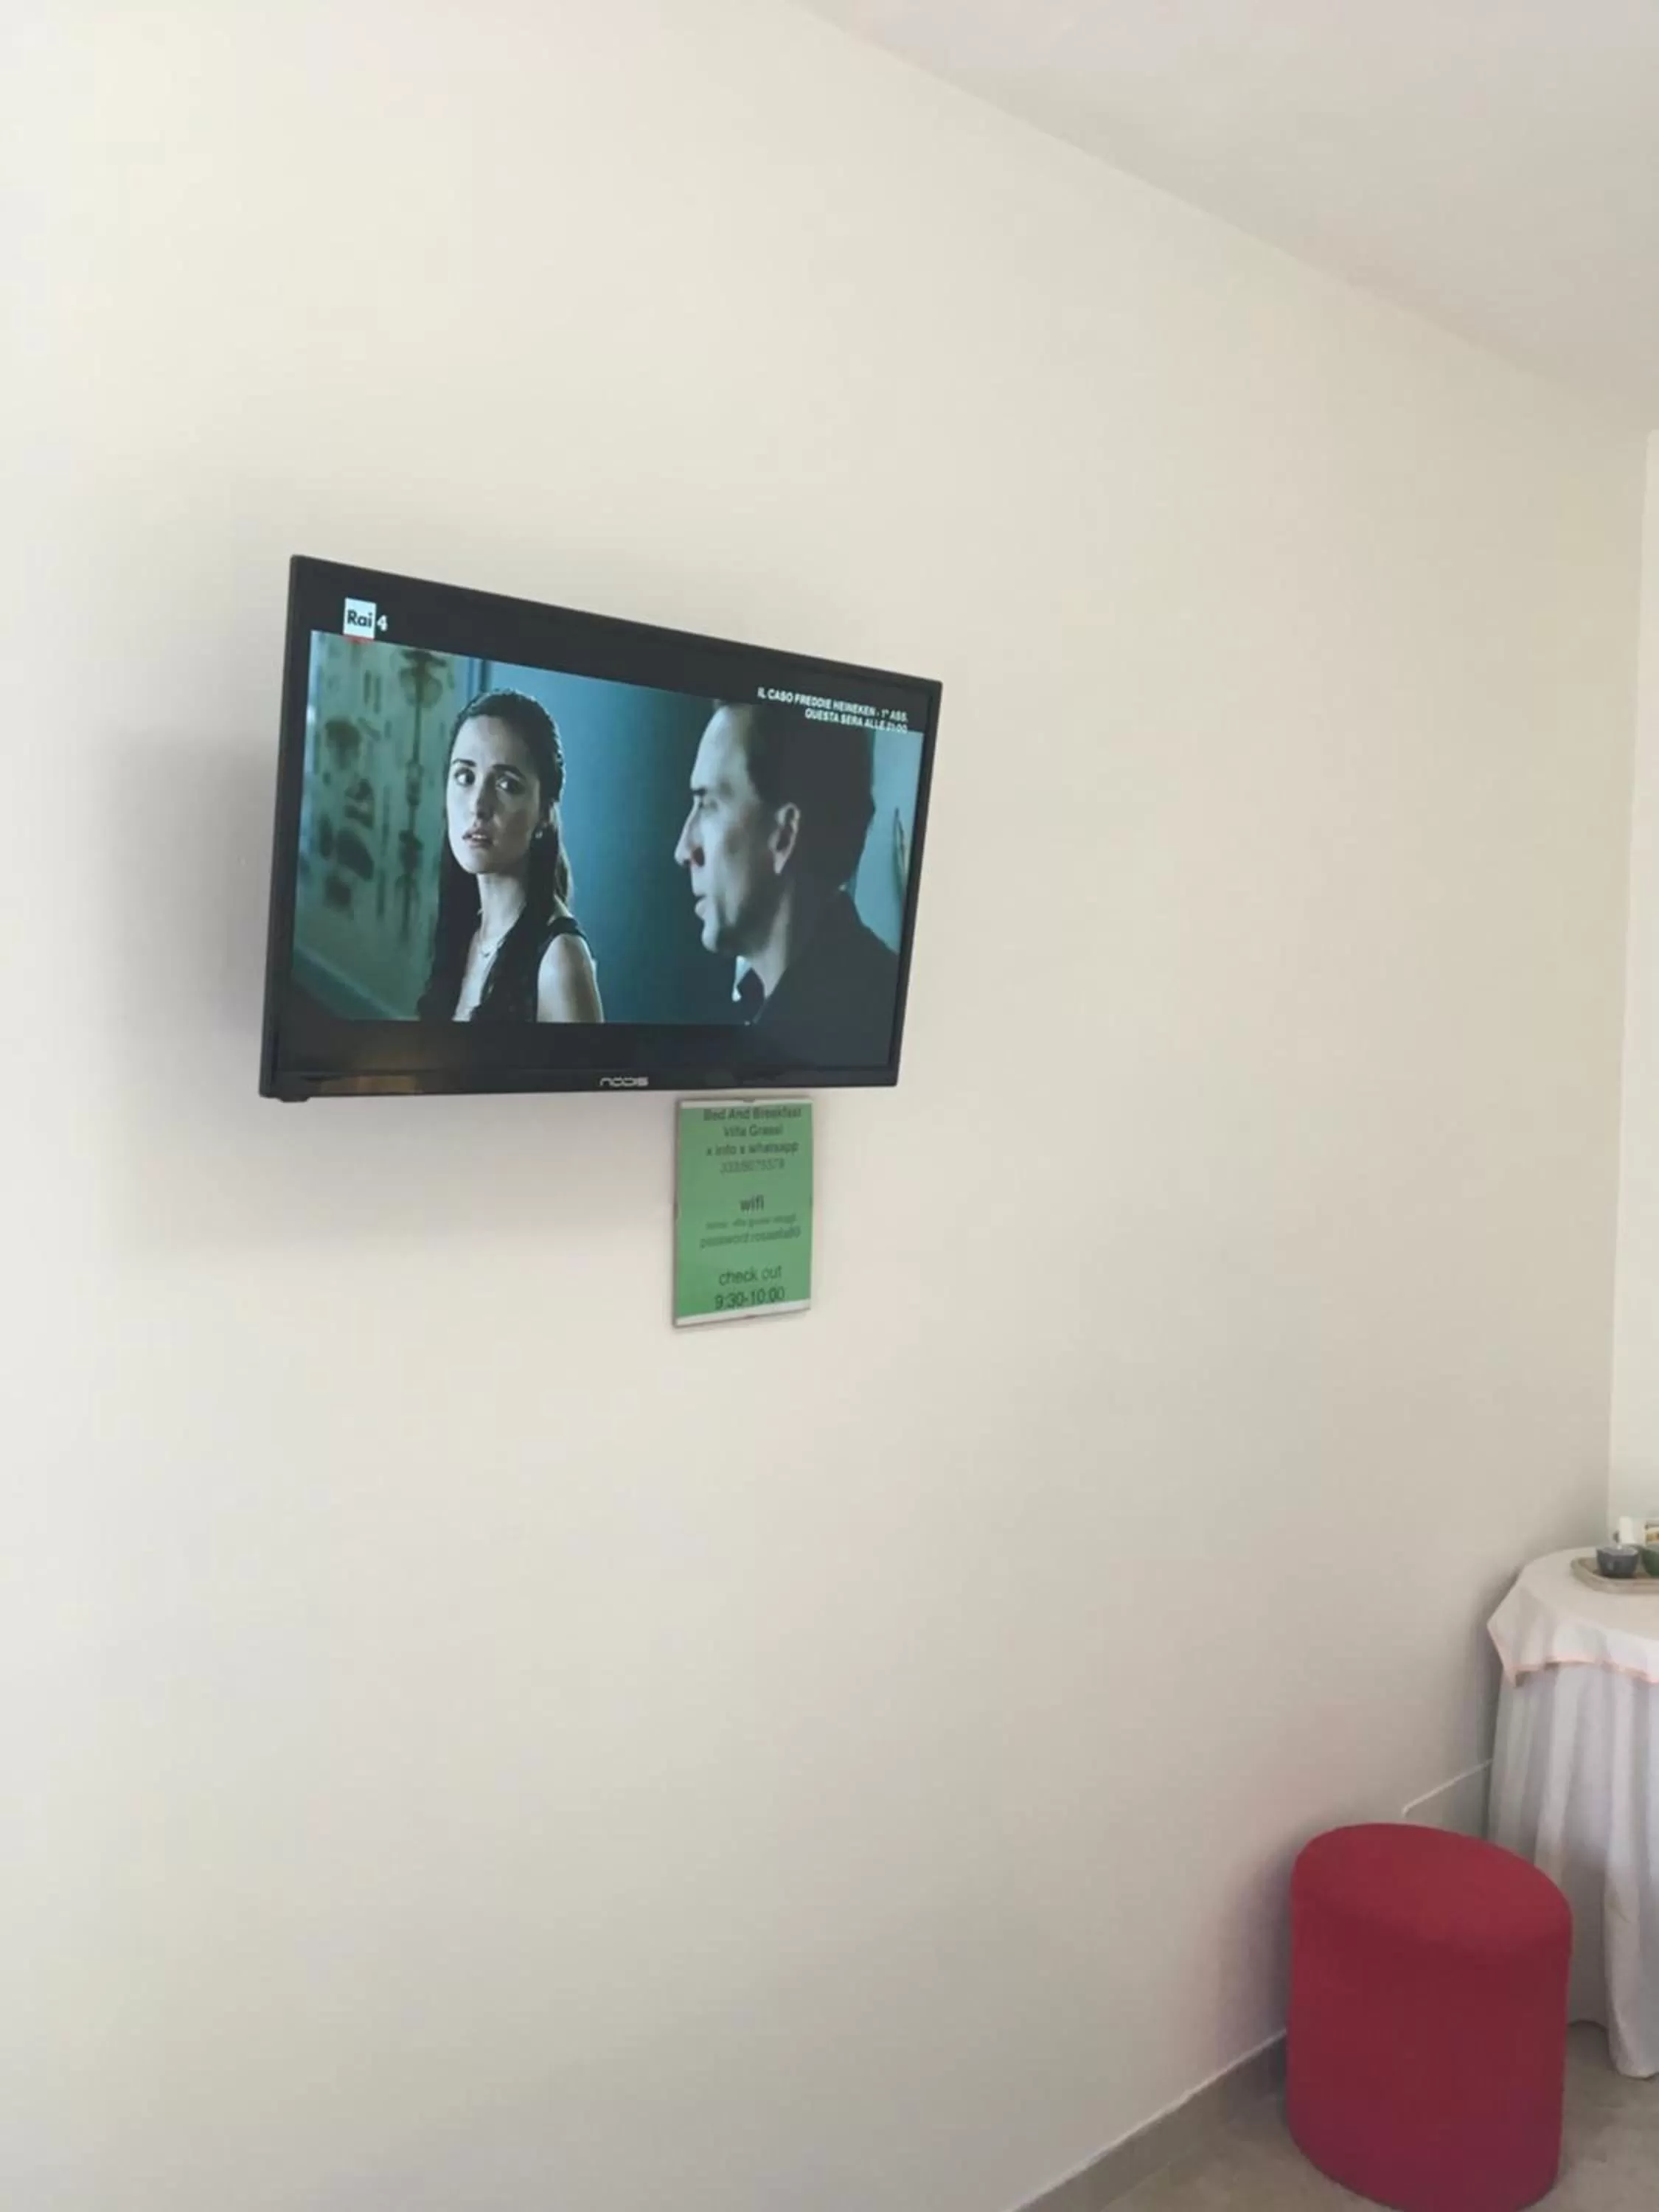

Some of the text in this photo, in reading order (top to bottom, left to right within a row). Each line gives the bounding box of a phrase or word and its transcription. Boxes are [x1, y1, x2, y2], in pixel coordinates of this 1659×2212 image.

[347, 609, 388, 632] Rai 4
[757, 686, 767, 699] IL
[767, 689, 794, 703] CASO
[794, 693, 832, 710] FREDDIE
[833, 700, 876, 717] HEINEKEN
[804, 707, 839, 723] QUESTA
[841, 713, 863, 726] SERA
[864, 717, 886, 731] ALLE
[703, 1106, 801, 1121] Bed And Breakfast
[740, 1194, 765, 1211] wifi
[719, 1264, 782, 1286] check out
